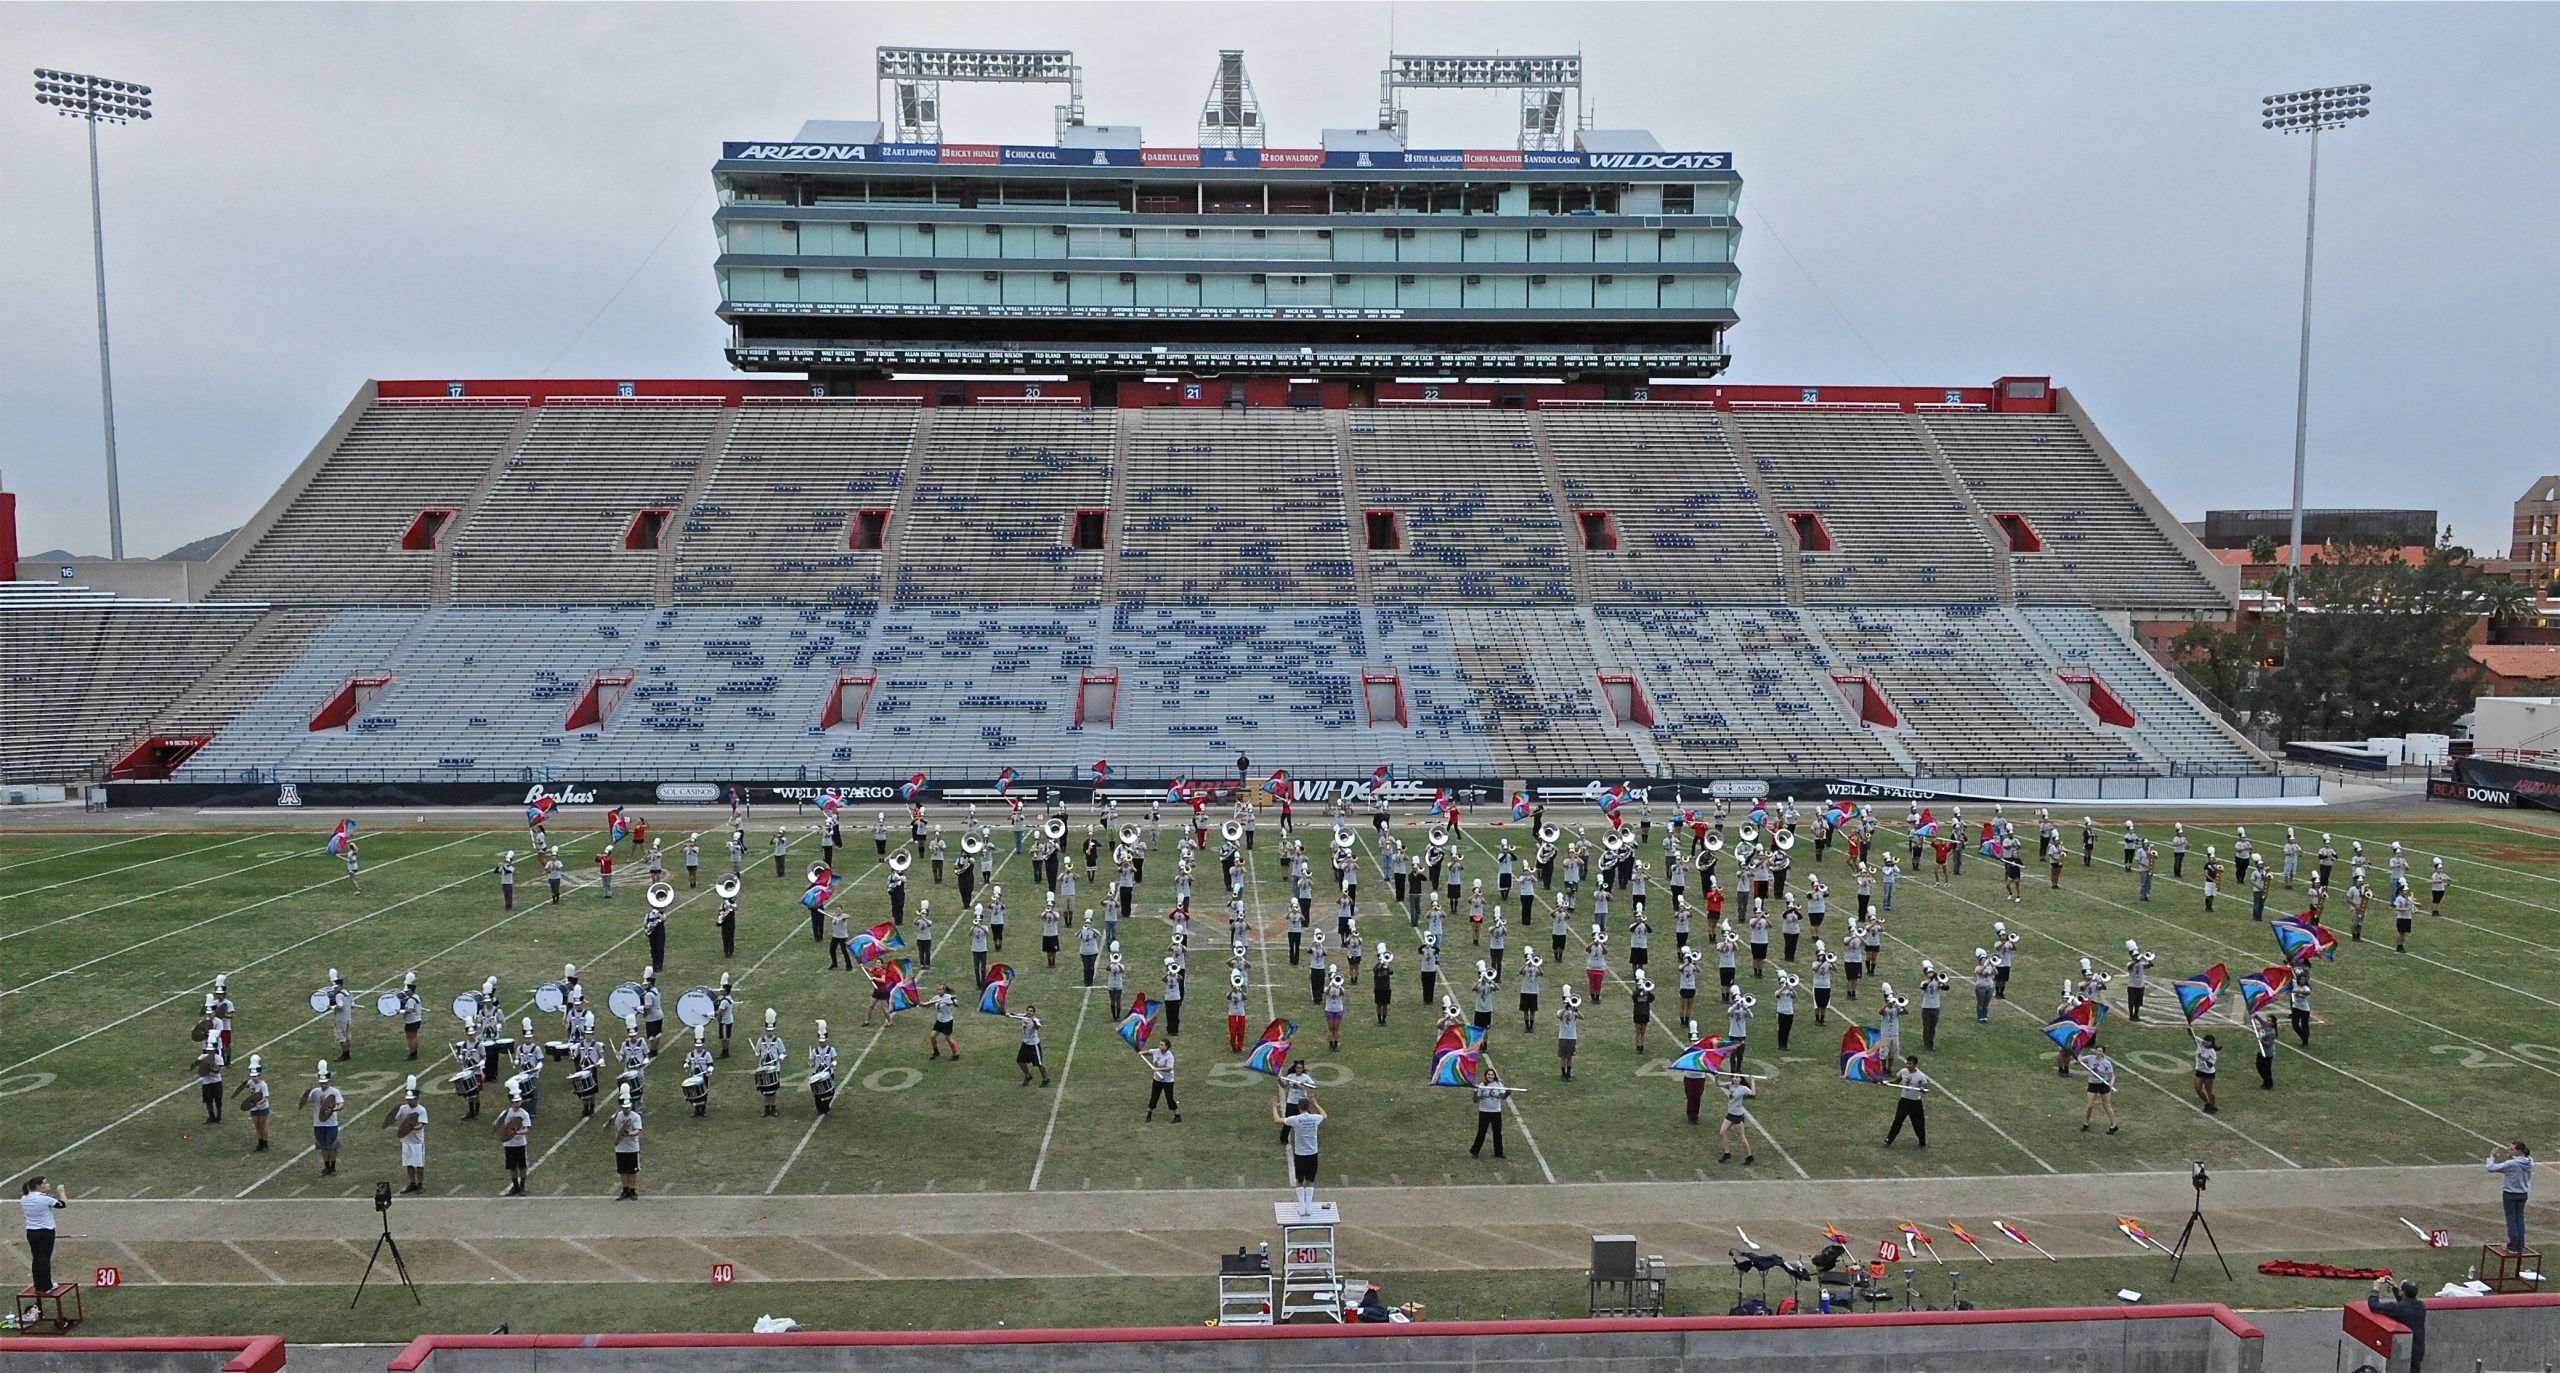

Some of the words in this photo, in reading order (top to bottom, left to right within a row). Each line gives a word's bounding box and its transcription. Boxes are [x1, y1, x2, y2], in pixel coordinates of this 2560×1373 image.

[738, 145, 866, 160] ARIZONA
[882, 148, 891, 156] 22
[892, 148, 905, 156] ART
[906, 149, 936, 157] LUPPINO
[973, 150, 999, 158] HUNLEY
[1011, 151, 1035, 159] CHUCK
[1142, 153, 1147, 161] 4
[1148, 153, 1176, 161] DARRYLL
[1464, 154, 1470, 162] 11
[1558, 156, 1580, 164] CASON
[1590, 155, 1725, 168] WILDCATS
[450, 388, 461, 397] 17
[620, 387, 632, 396] 18
[812, 387, 824, 397] 19
[1026, 388, 1040, 398] 20
[1187, 389, 1199, 399] 21
[1425, 390, 1438, 400] 22
[1634, 392, 1647, 401] 23
[1804, 394, 1816, 403] 24
[1947, 395, 1960, 404] 25
[61, 568, 73, 577] 16
[781, 787, 836, 799] WELLS
[841, 787, 894, 798] FARGO
[1293, 780, 1423, 800] WILDCATS
[1826, 784, 1879, 796] WELLS
[1884, 787, 1935, 799] FARGO
[2434, 783, 2465, 798] BEAR
[2467, 788, 2509, 804] DOWN
[1208, 1062, 1355, 1088] 50
[2434, 1231, 2448, 1247] 30
[1299, 1248, 1316, 1263] 50
[1881, 1242, 1895, 1260] 40
[98, 1269, 115, 1286] 30
[714, 1266, 731, 1282] 40
